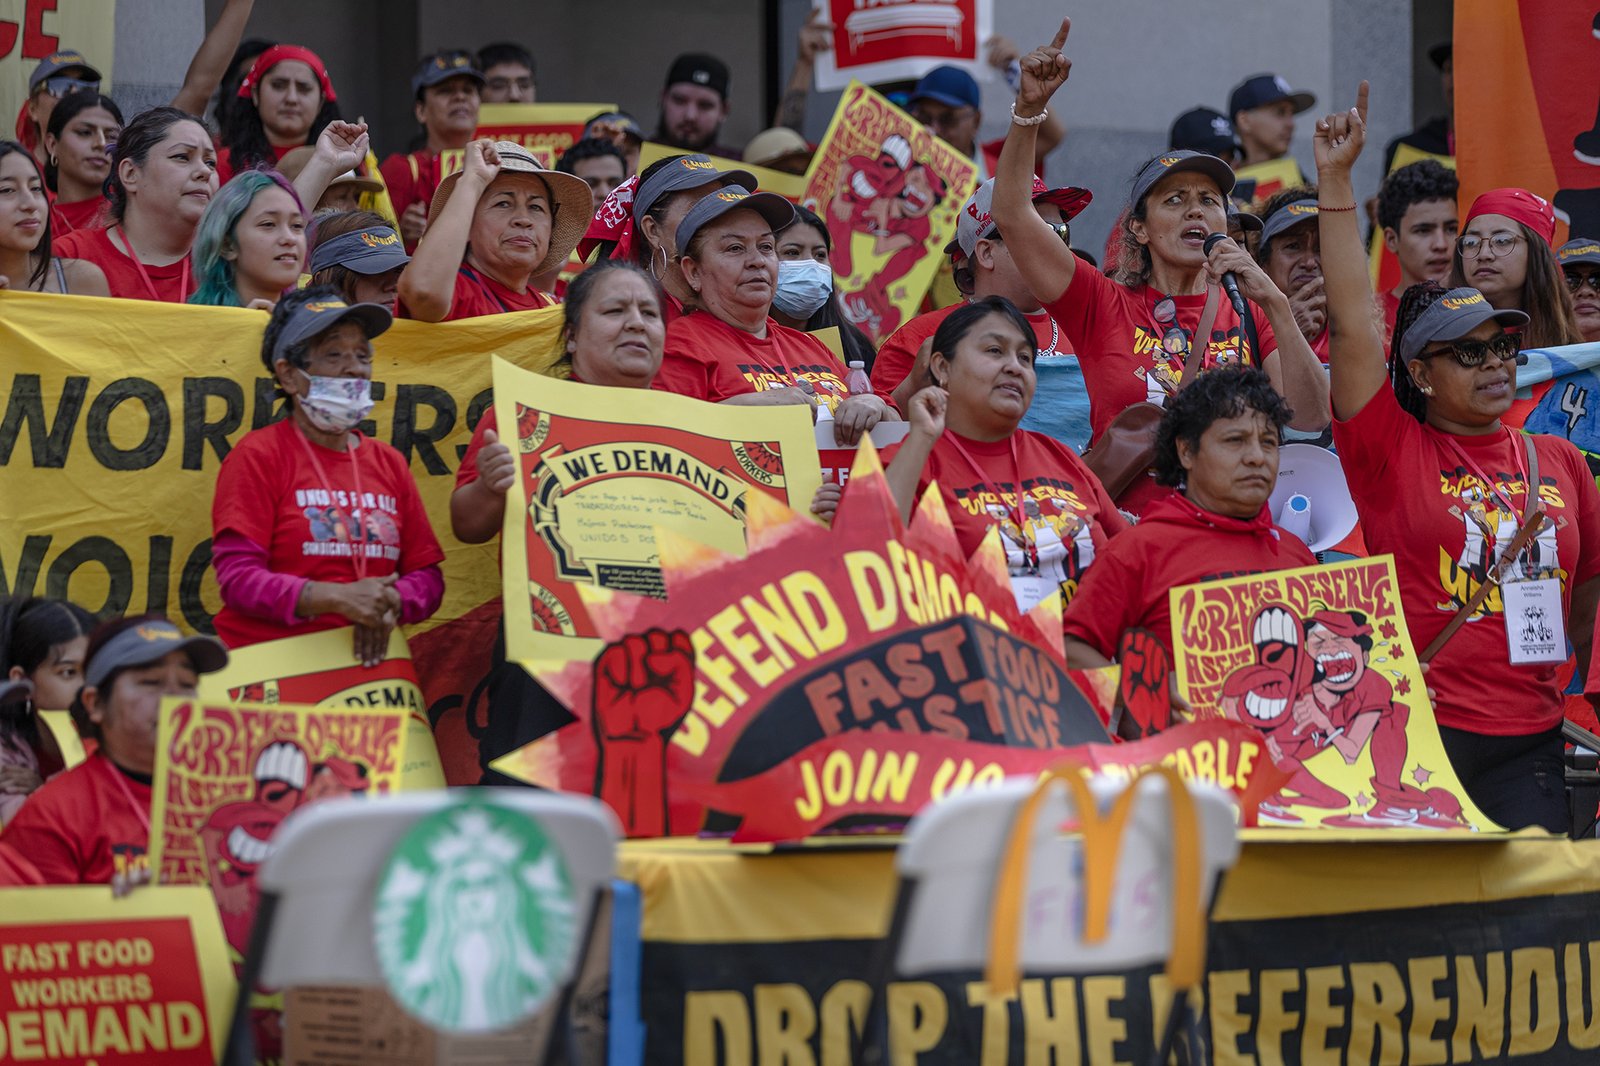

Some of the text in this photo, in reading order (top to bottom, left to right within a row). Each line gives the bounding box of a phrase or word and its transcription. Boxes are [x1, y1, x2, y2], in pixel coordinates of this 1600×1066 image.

[562, 448, 729, 500] WE DEMAND
[735, 446, 773, 484] WORKERS
[1179, 578, 1283, 651] WORKERS
[1285, 562, 1396, 619] DESERVE
[804, 623, 1061, 738] FAST FOOD
[1200, 648, 1252, 683] SEAT
[1188, 682, 1222, 704] AT
[796, 748, 919, 820] JOIN
[3, 938, 154, 973] FAST FOOD
[11, 973, 154, 1008] WORKERS
[0, 1001, 204, 1061] EMAND
